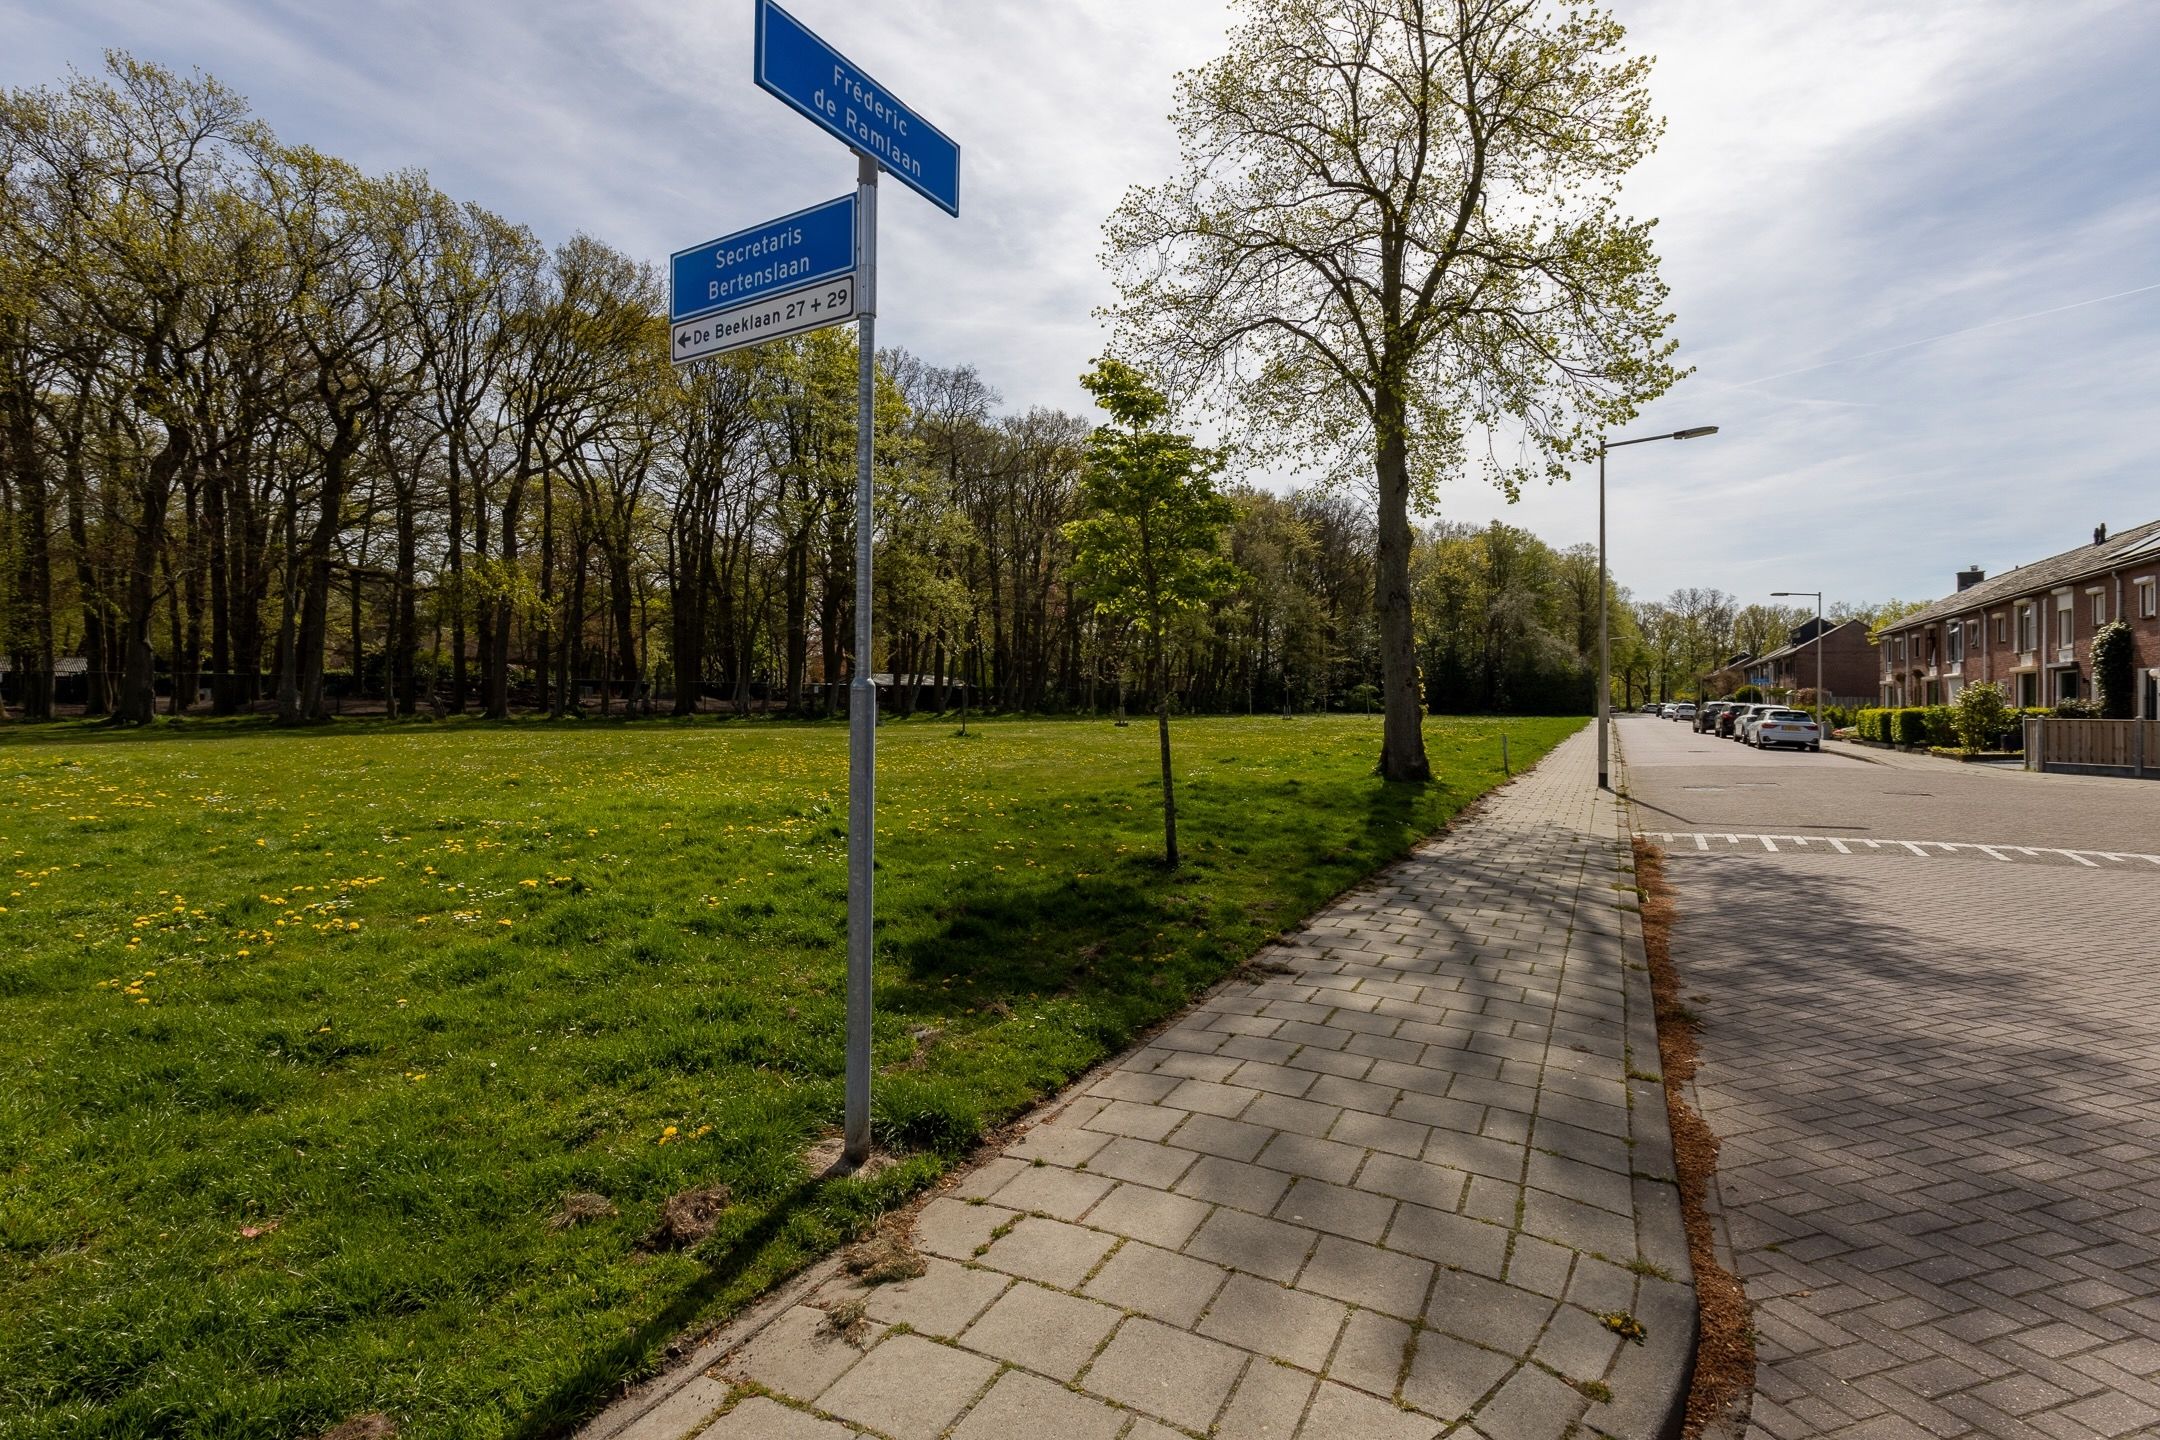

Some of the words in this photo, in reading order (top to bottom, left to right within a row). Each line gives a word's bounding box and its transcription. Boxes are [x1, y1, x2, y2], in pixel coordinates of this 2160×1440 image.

[833, 64, 907, 137] Fréderic
[814, 89, 837, 118] de
[845, 107, 921, 178] Ramlaan
[716, 227, 802, 269] Secretaris
[709, 256, 810, 300] Bertenslaan
[693, 330, 710, 345] De
[715, 310, 780, 339] Beeklaan
[786, 301, 806, 320] 27
[810, 298, 822, 313] +
[827, 289, 848, 309] 29
